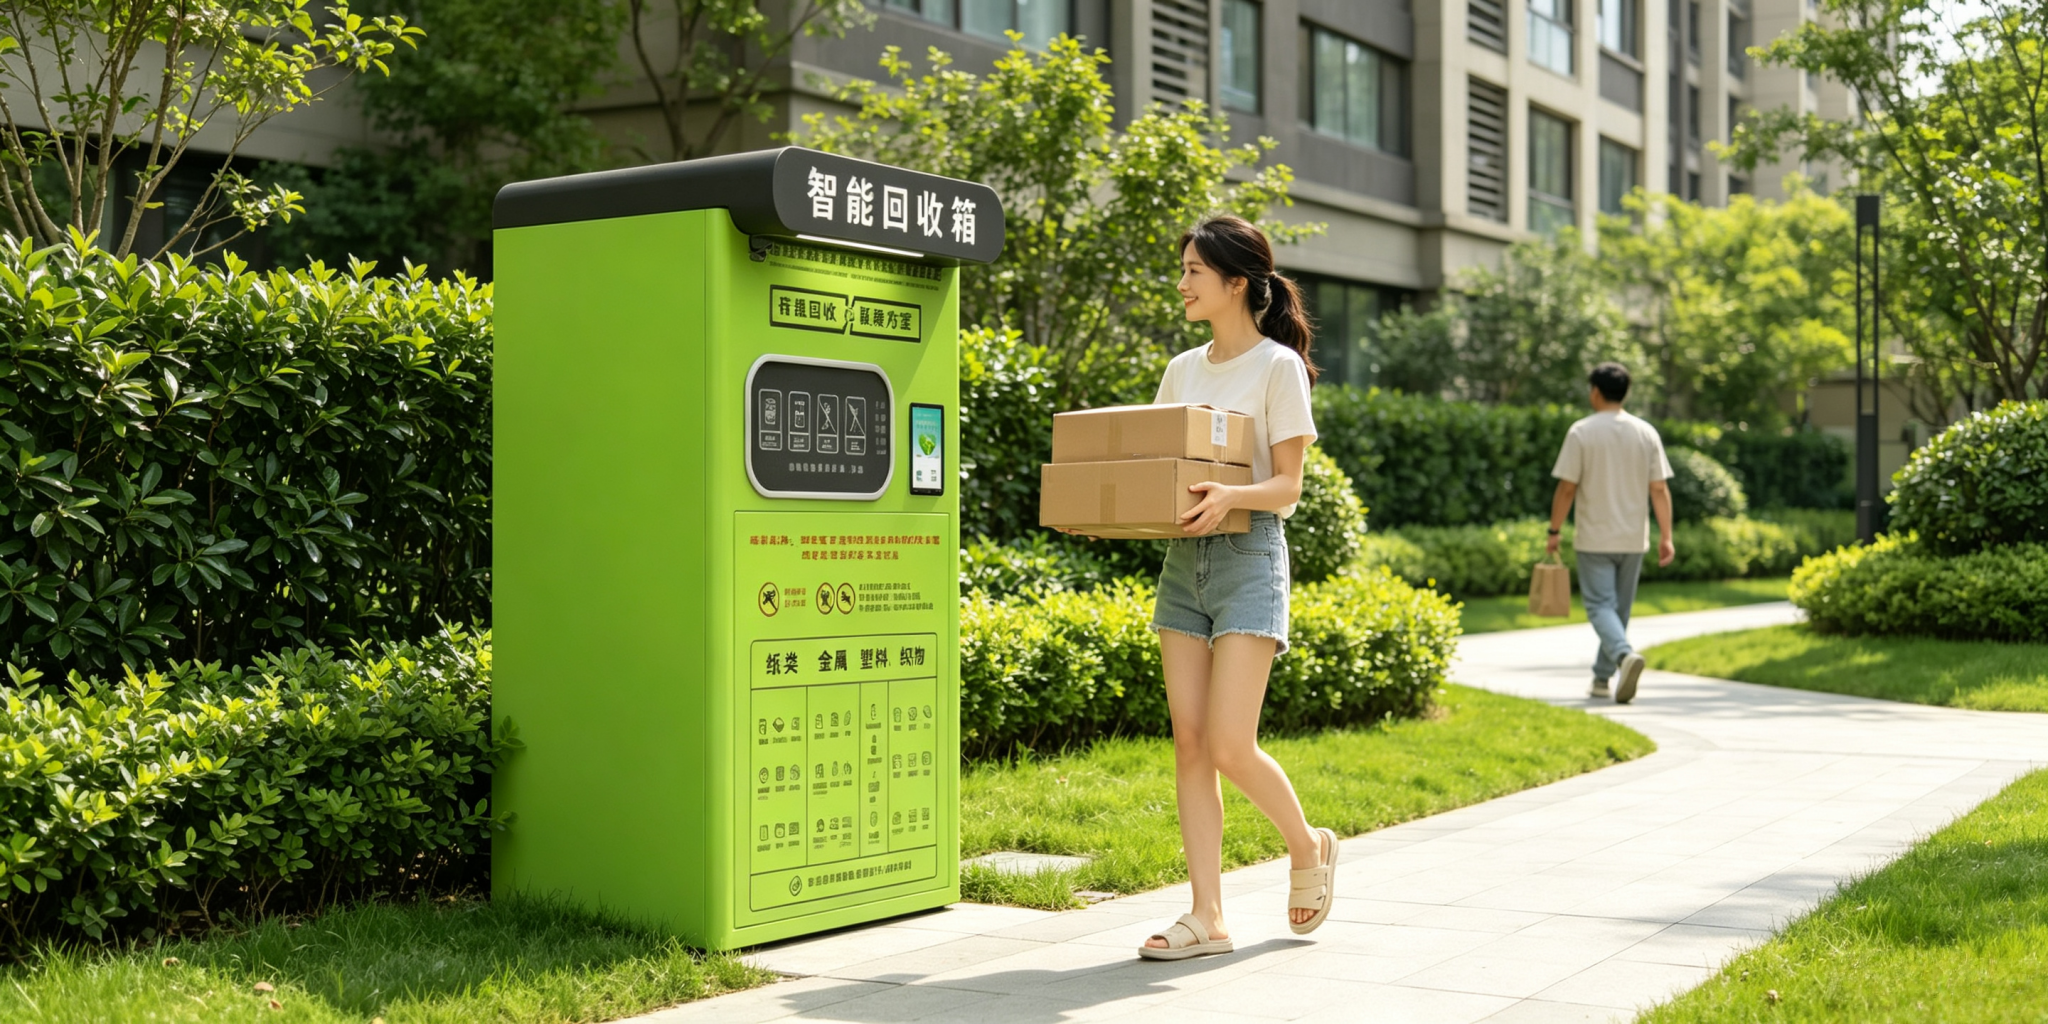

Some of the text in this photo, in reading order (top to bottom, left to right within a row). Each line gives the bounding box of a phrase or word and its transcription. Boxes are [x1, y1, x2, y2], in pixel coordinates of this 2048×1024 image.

[807, 166, 977, 246] 智能回收箱
[818, 650, 848, 672] 金属
